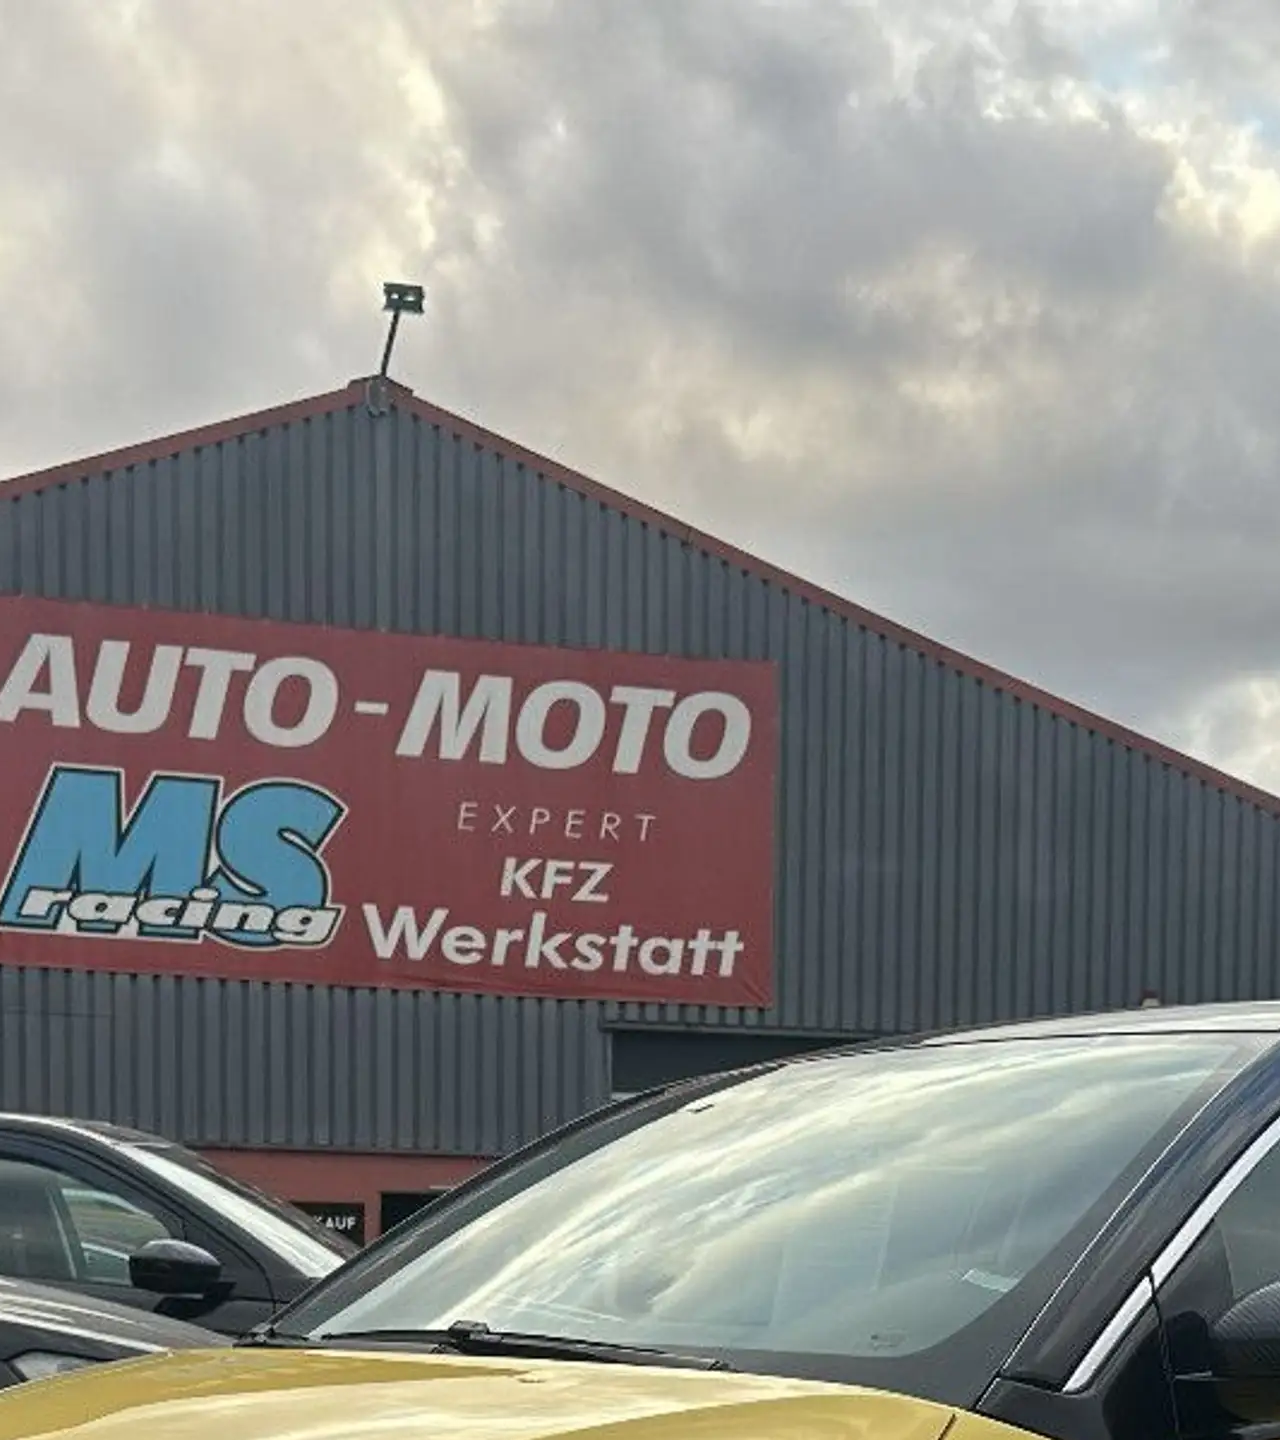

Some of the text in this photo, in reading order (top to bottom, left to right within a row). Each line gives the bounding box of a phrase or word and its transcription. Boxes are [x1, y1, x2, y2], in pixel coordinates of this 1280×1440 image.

[457, 801, 657, 842] EXPERT
[499, 856, 614, 903] KFZ
[17, 886, 342, 945] racing
[362, 904, 744, 978] Werkstatt
